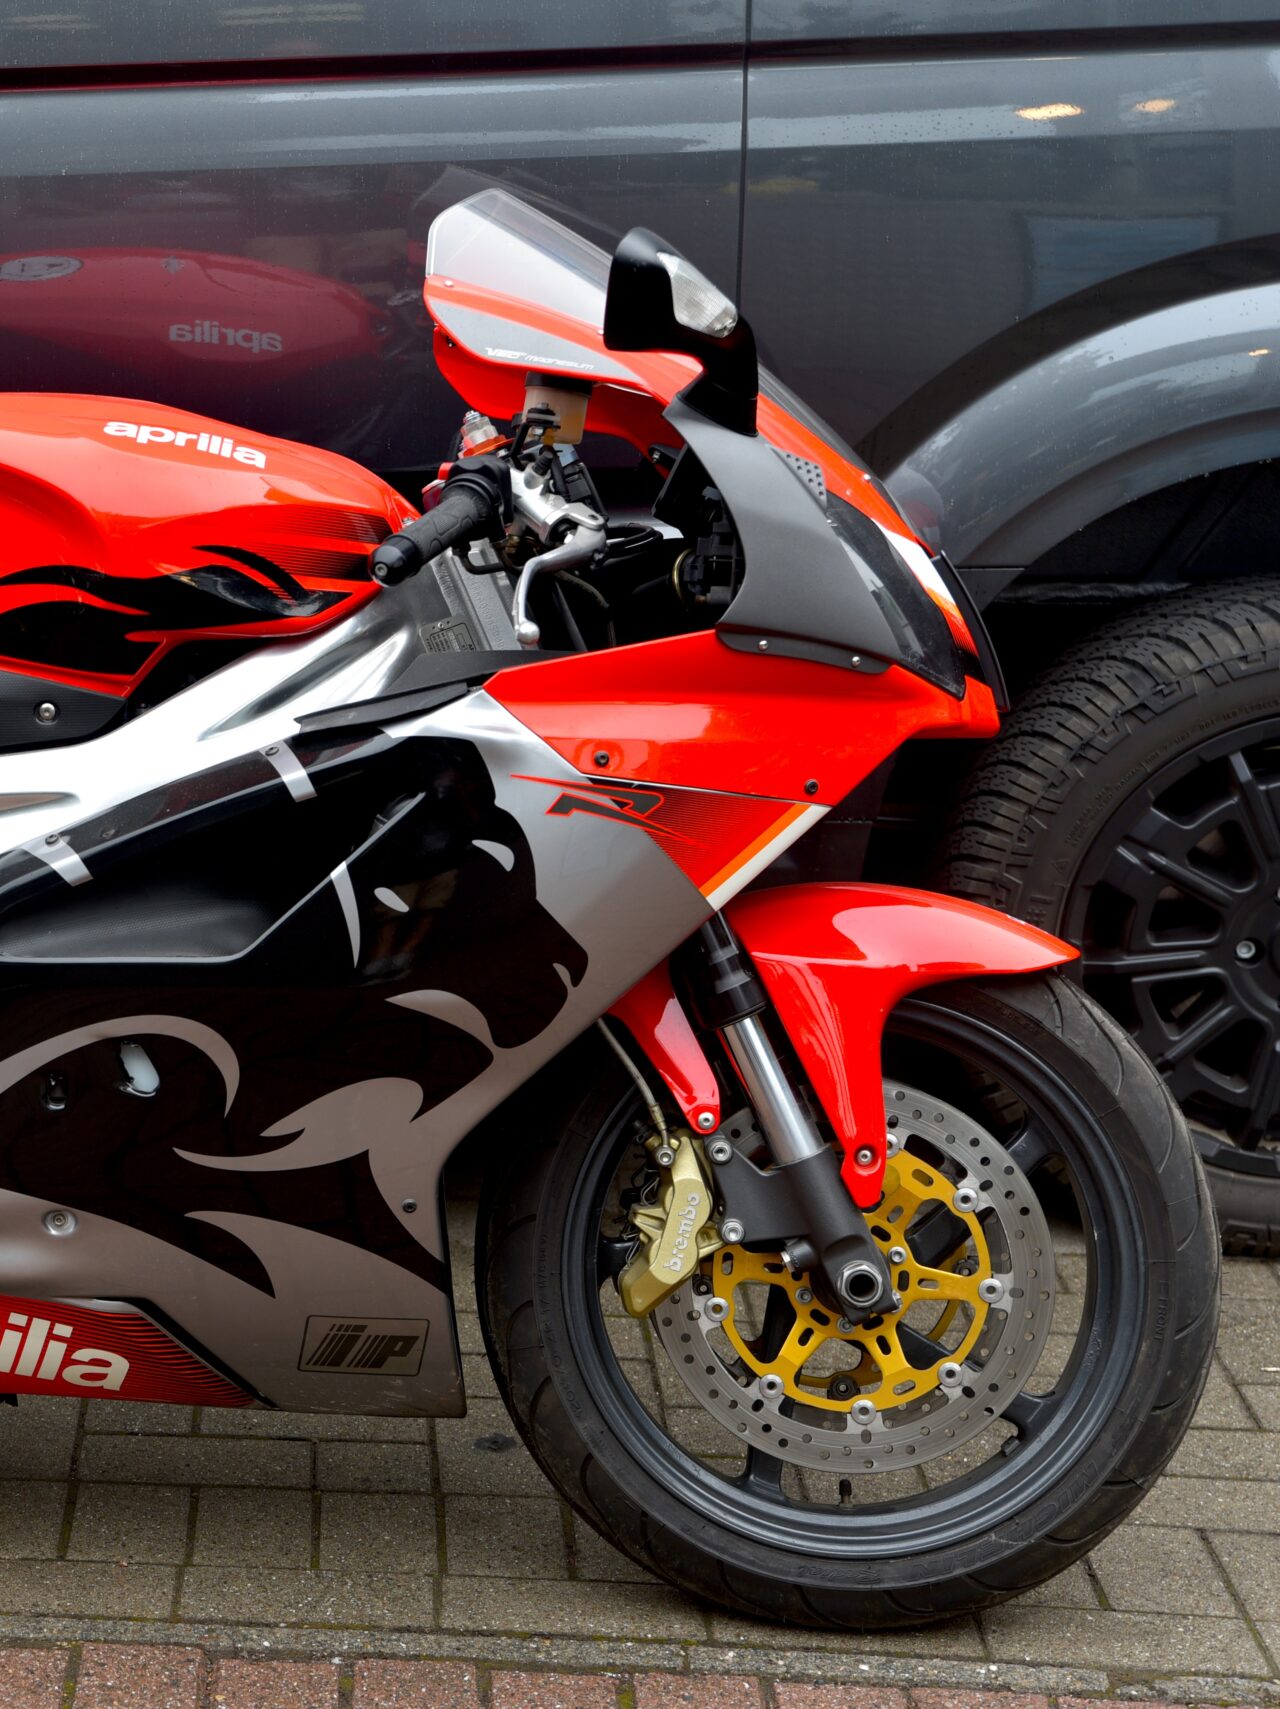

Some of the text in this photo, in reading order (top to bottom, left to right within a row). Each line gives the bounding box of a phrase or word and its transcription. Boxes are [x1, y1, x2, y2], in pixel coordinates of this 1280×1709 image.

[103, 421, 267, 469] aprilia
[663, 1192, 701, 1272] brembo
[1154, 1297, 1169, 1343] FRONT
